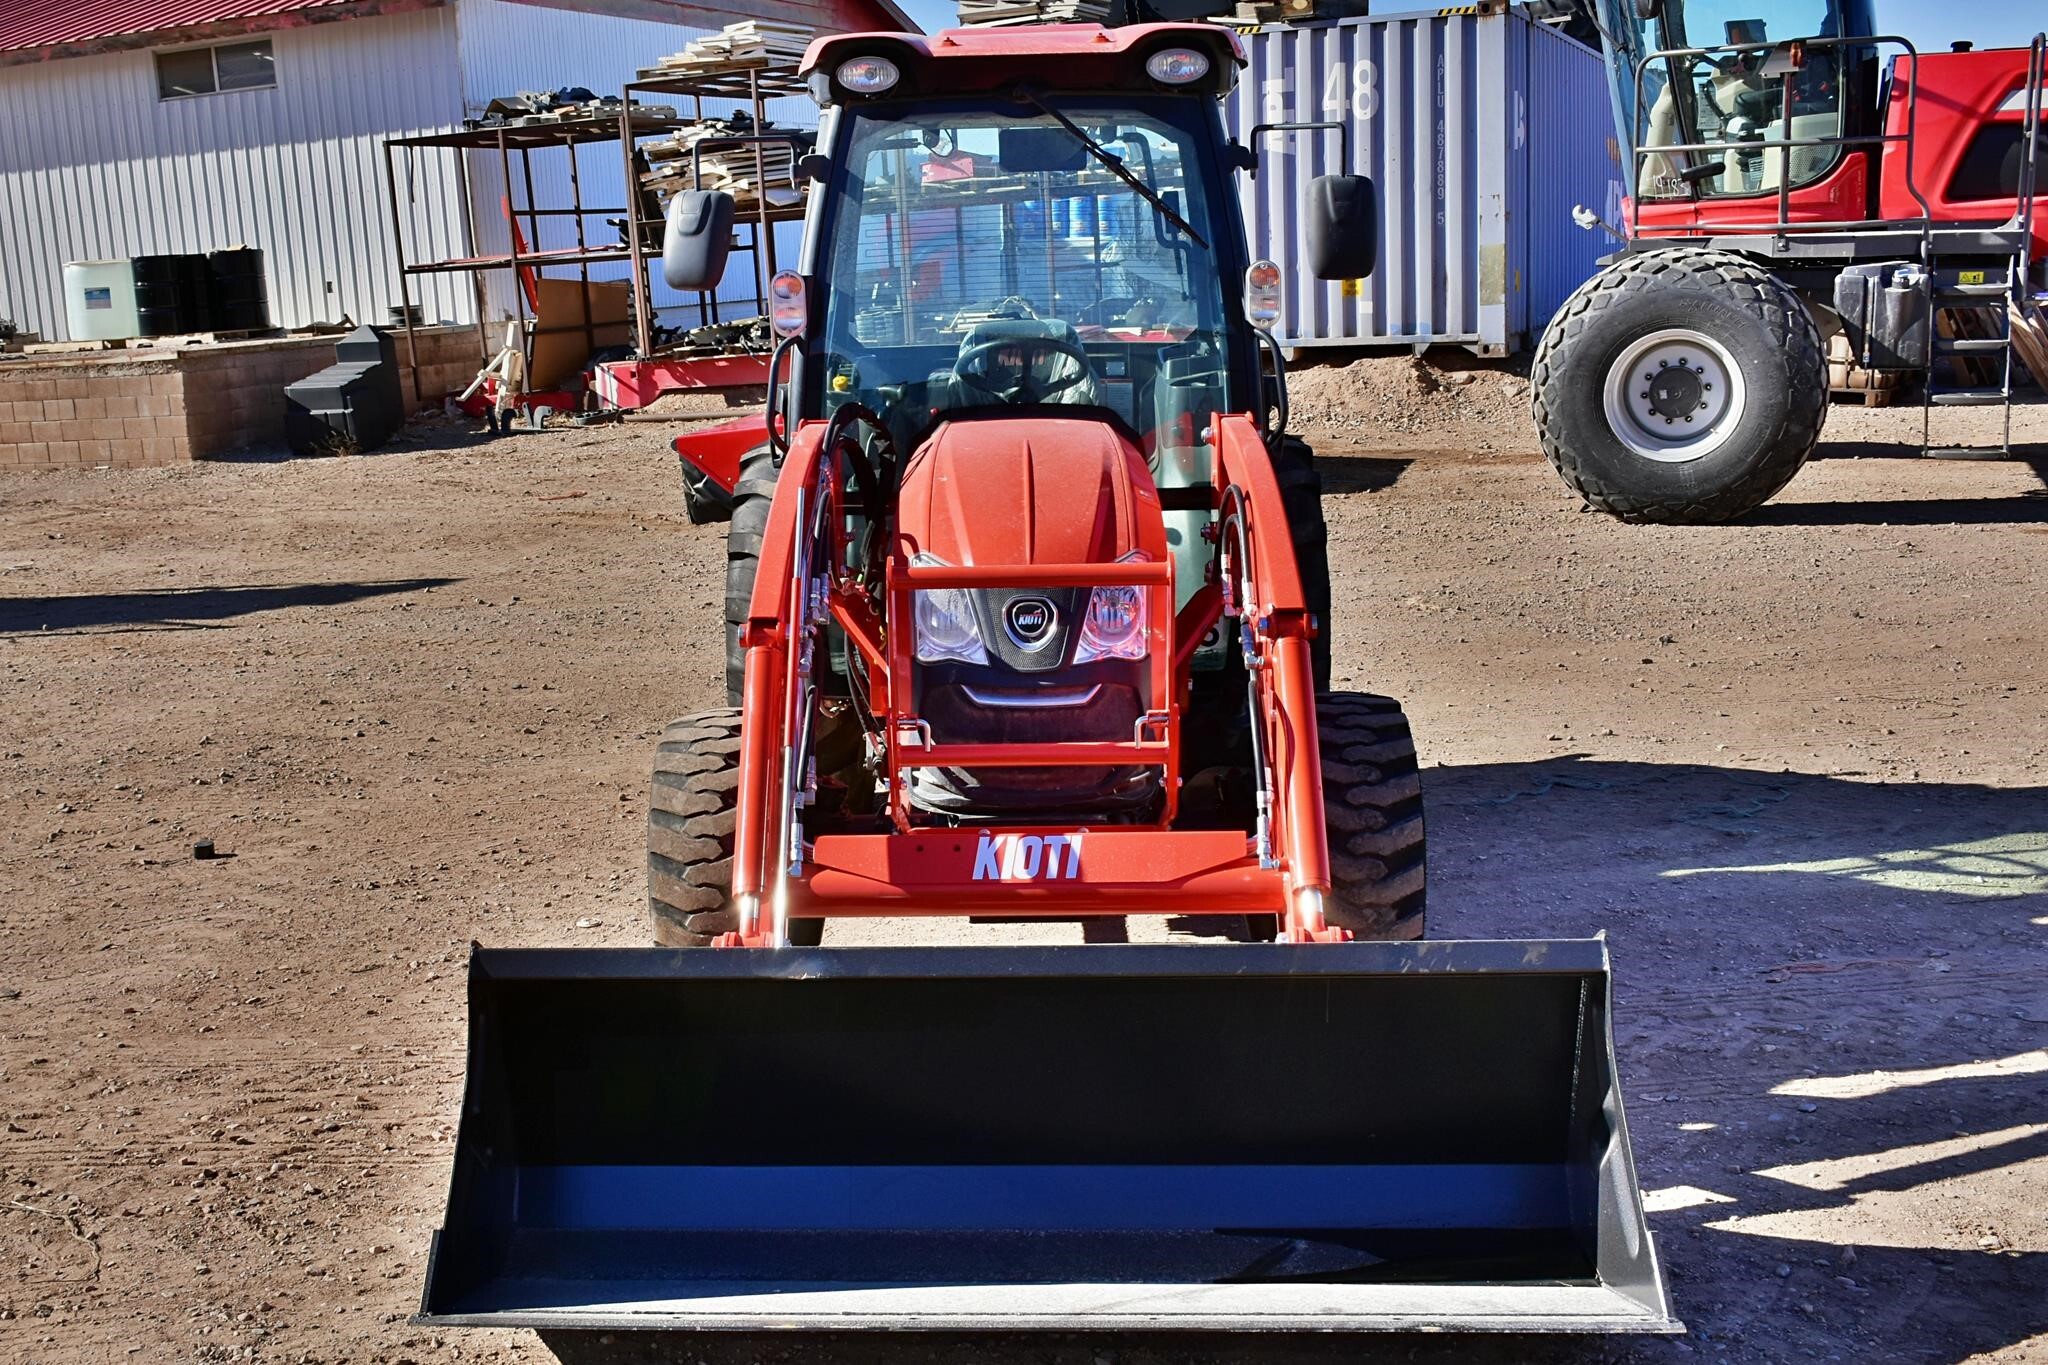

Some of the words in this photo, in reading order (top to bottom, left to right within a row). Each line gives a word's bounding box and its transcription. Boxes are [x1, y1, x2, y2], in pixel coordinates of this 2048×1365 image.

[1322, 59, 1379, 121] 48
[1437, 212, 1444, 224] 5
[1018, 613, 1042, 625] KIOTI
[972, 834, 1083, 880] KIOTI
